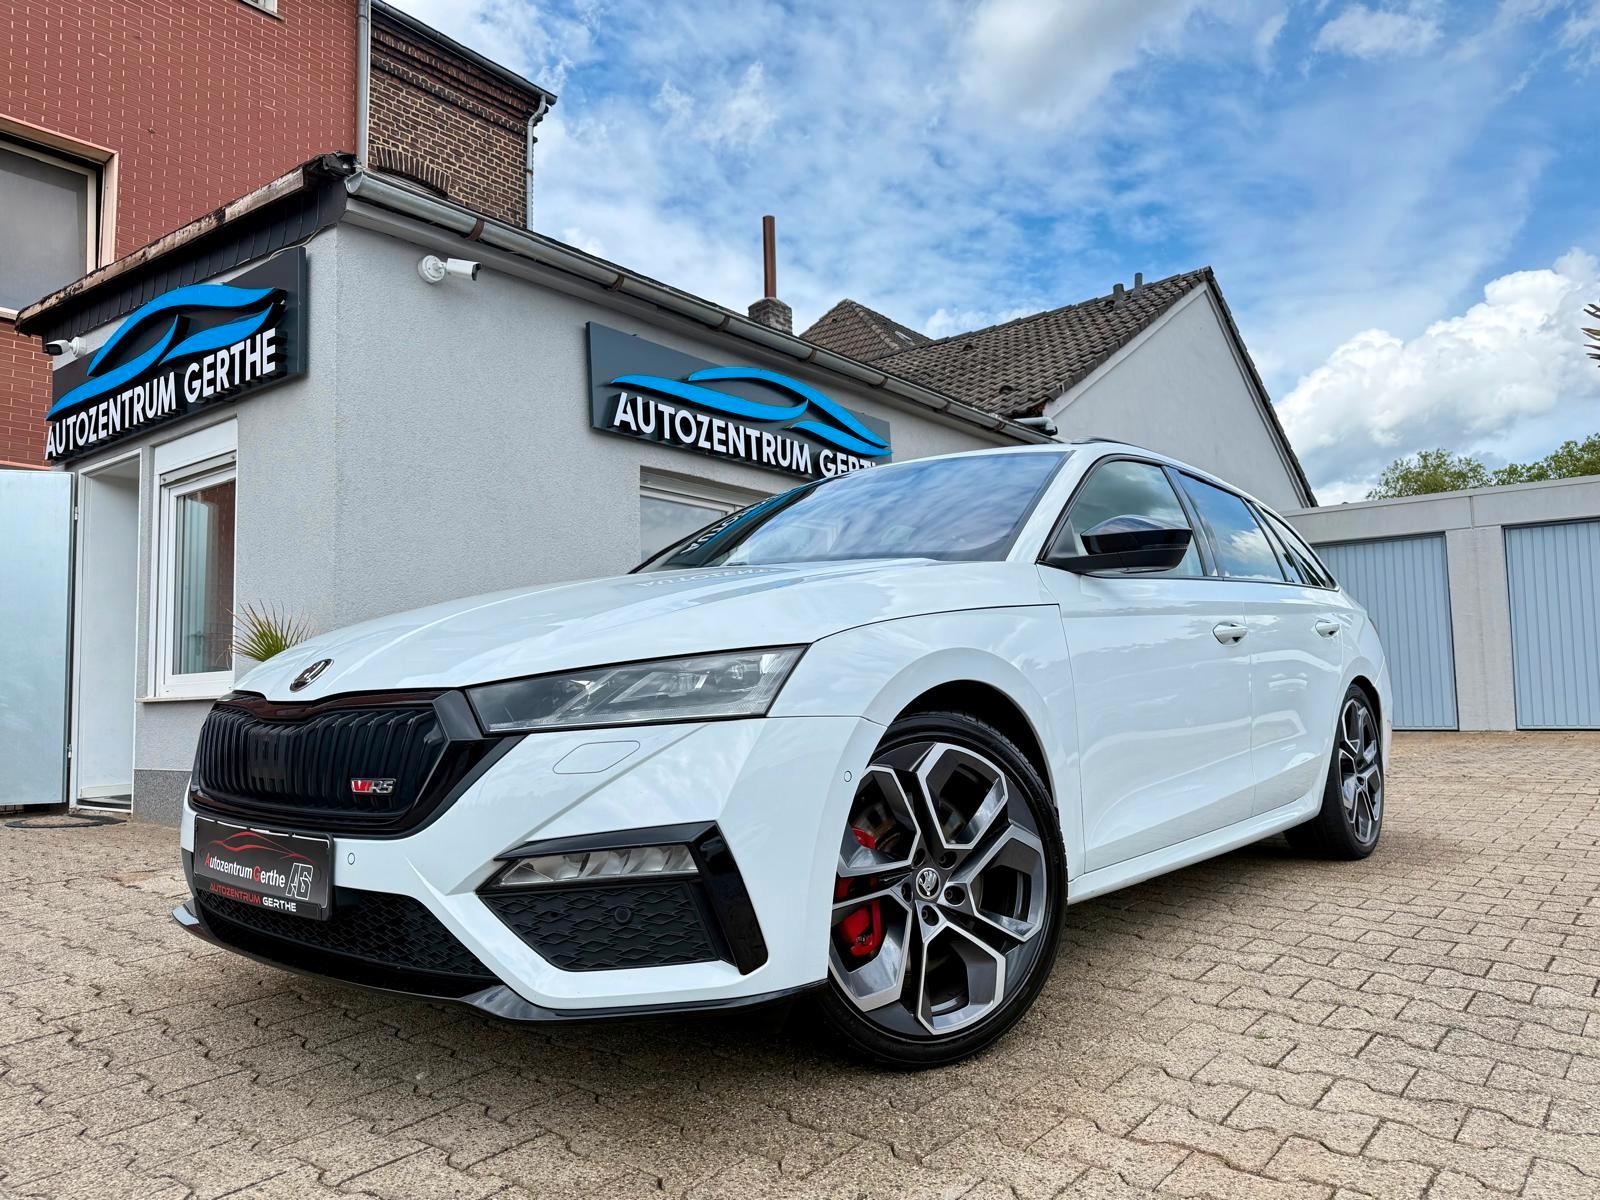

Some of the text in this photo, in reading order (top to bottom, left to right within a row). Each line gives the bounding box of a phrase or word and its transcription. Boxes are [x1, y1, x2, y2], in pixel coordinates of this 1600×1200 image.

[45, 328, 276, 460] AUTOZENTRUM GERTHE
[613, 391, 812, 474] AUTOZENTRUM
[209, 883, 297, 912] AUTOZENTRUM GERTHE
